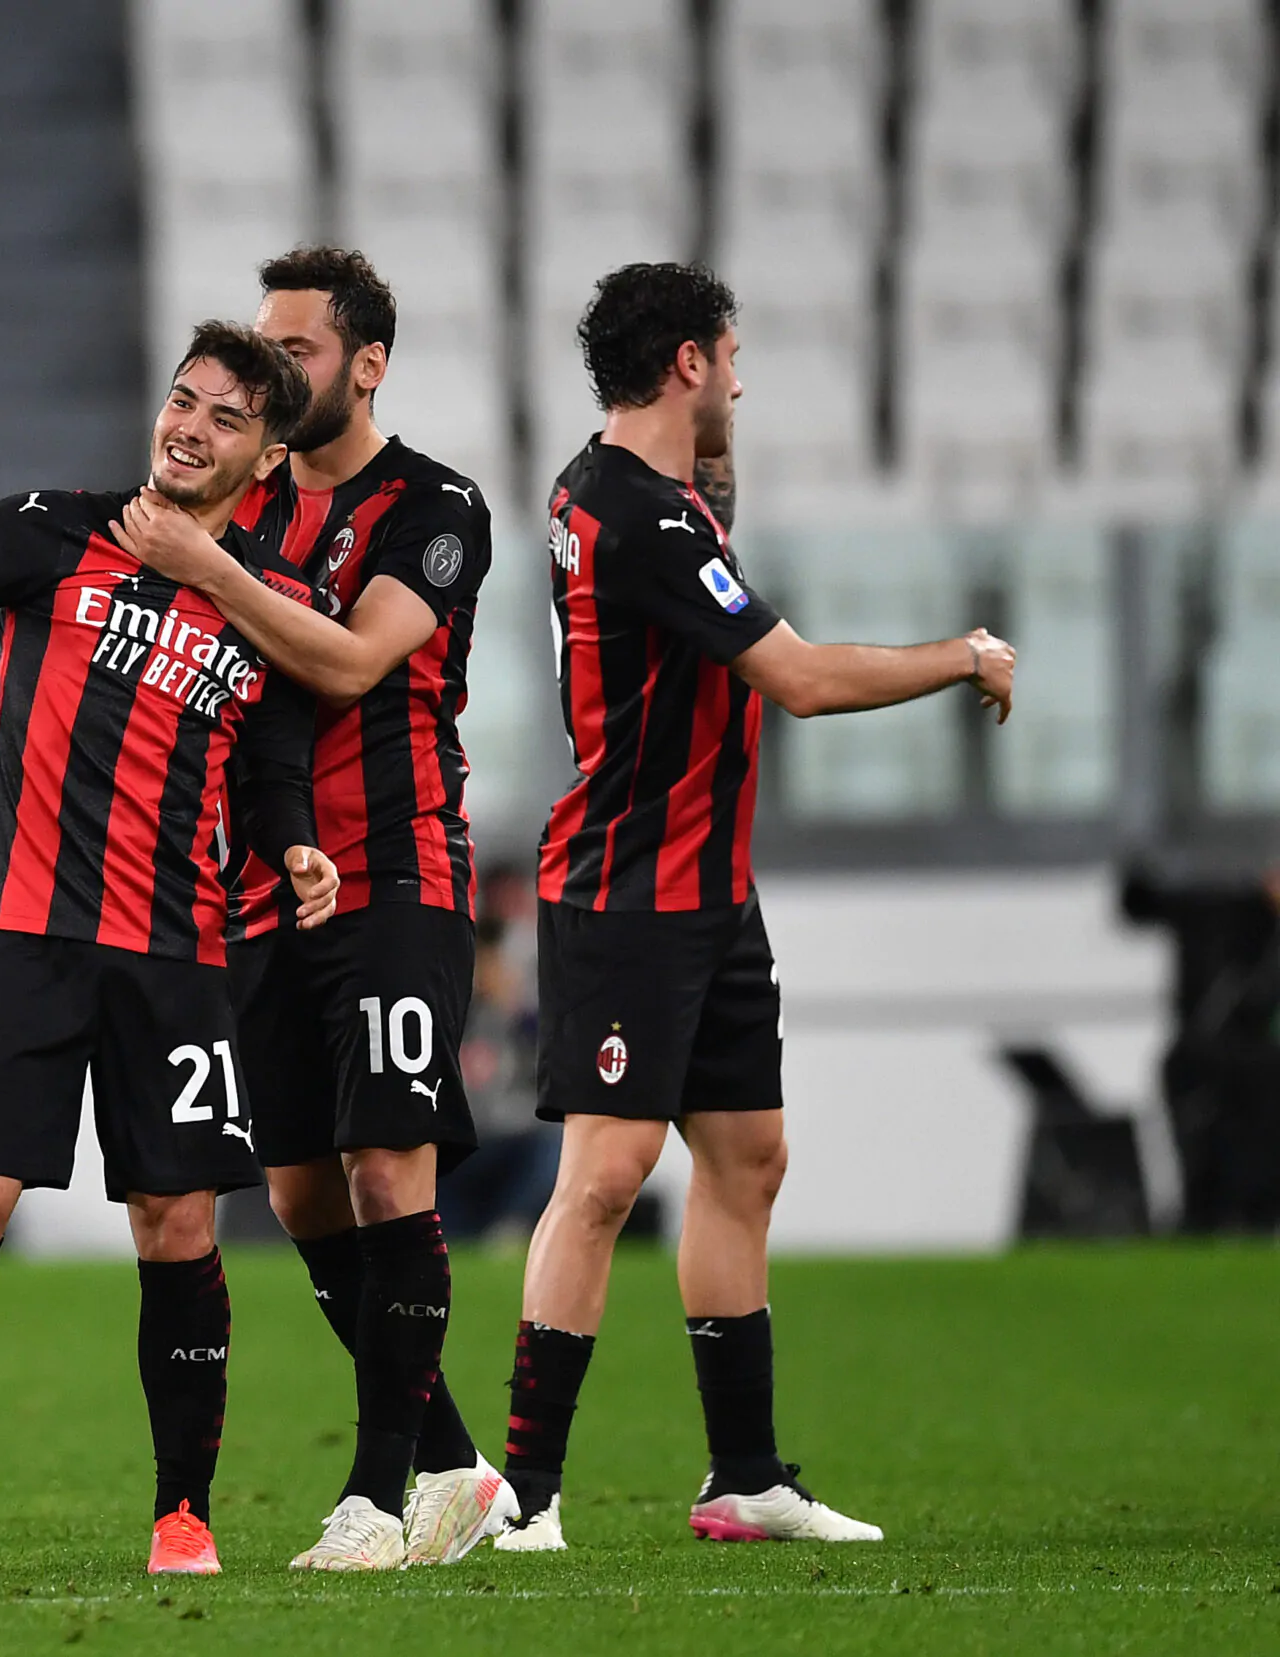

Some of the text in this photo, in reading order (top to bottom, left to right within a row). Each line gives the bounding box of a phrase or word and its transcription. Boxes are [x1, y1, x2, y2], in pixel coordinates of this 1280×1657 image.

[76, 586, 257, 700] Emirates
[92, 631, 230, 718] FLY BETTER
[360, 997, 433, 1074] 10
[167, 1040, 240, 1124] 21
[387, 1302, 446, 1319] ACM
[170, 1346, 226, 1361] ACM
